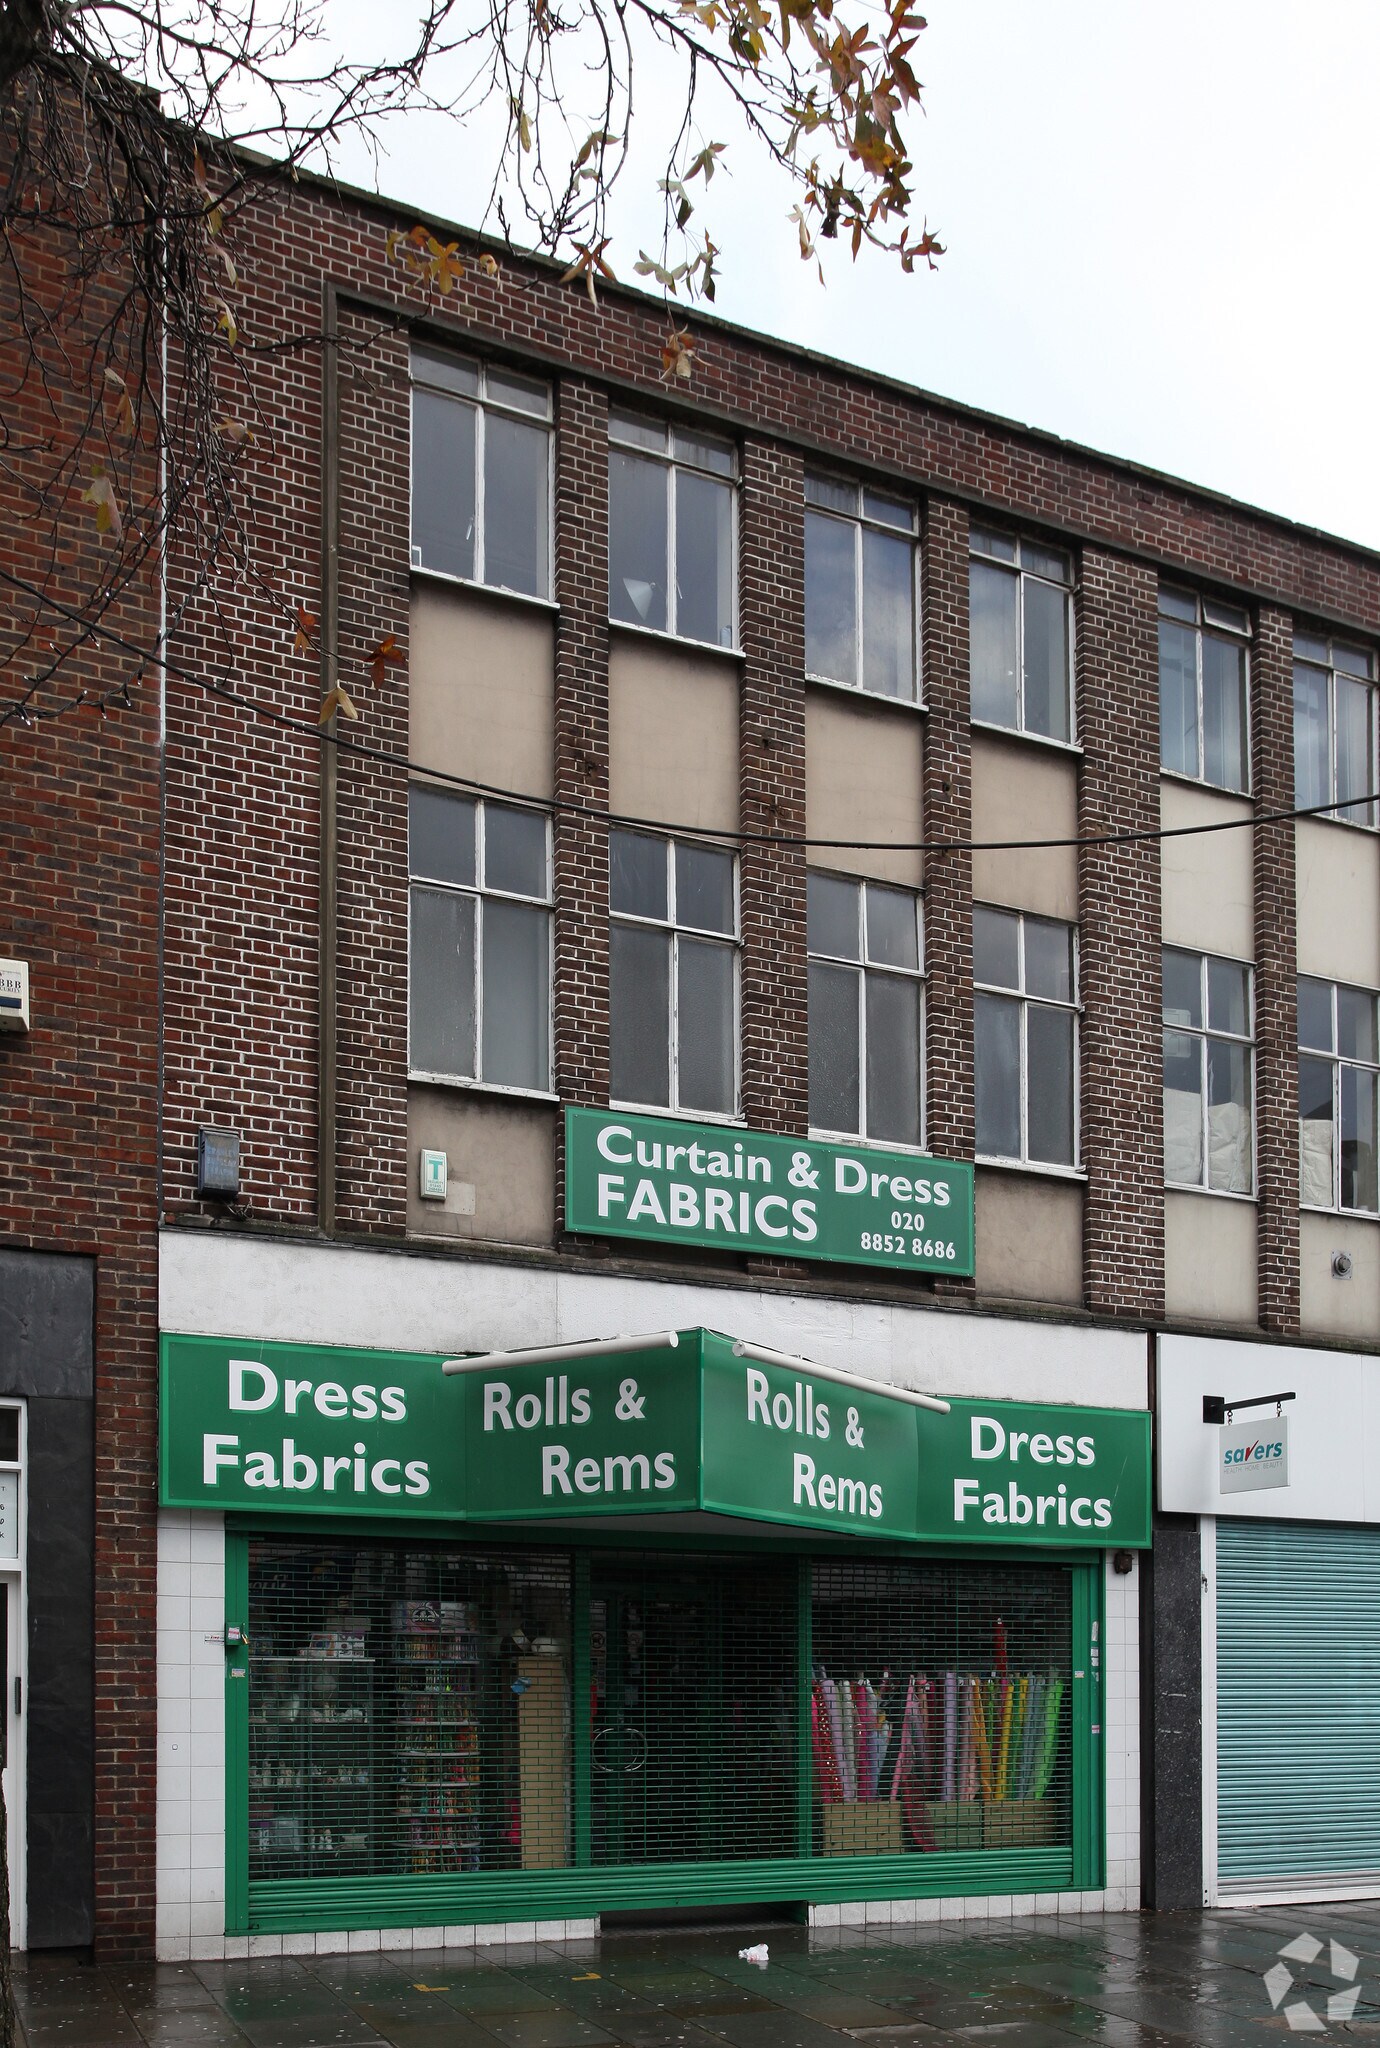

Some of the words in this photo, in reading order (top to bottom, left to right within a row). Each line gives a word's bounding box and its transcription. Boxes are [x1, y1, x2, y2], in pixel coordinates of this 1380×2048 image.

[596, 1125, 772, 1183] Curtain
[787, 1151, 820, 1190] &
[834, 1157, 951, 1207] Dress
[597, 1173, 818, 1242] FABRICS
[891, 1210, 925, 1232] 020
[860, 1231, 906, 1255] 8852
[911, 1237, 956, 1260] 8686
[228, 1359, 407, 1421] Dress
[483, 1375, 591, 1431] Rolls
[614, 1378, 646, 1421] &
[746, 1367, 830, 1439] Rolls
[844, 1406, 865, 1449] &
[203, 1433, 430, 1495] Fabrics
[970, 1416, 1096, 1466] Dress
[1224, 1440, 1283, 1464] savers
[542, 1445, 676, 1495] Rems
[793, 1452, 883, 1518] Rems
[953, 1478, 1112, 1528] Fabrics
